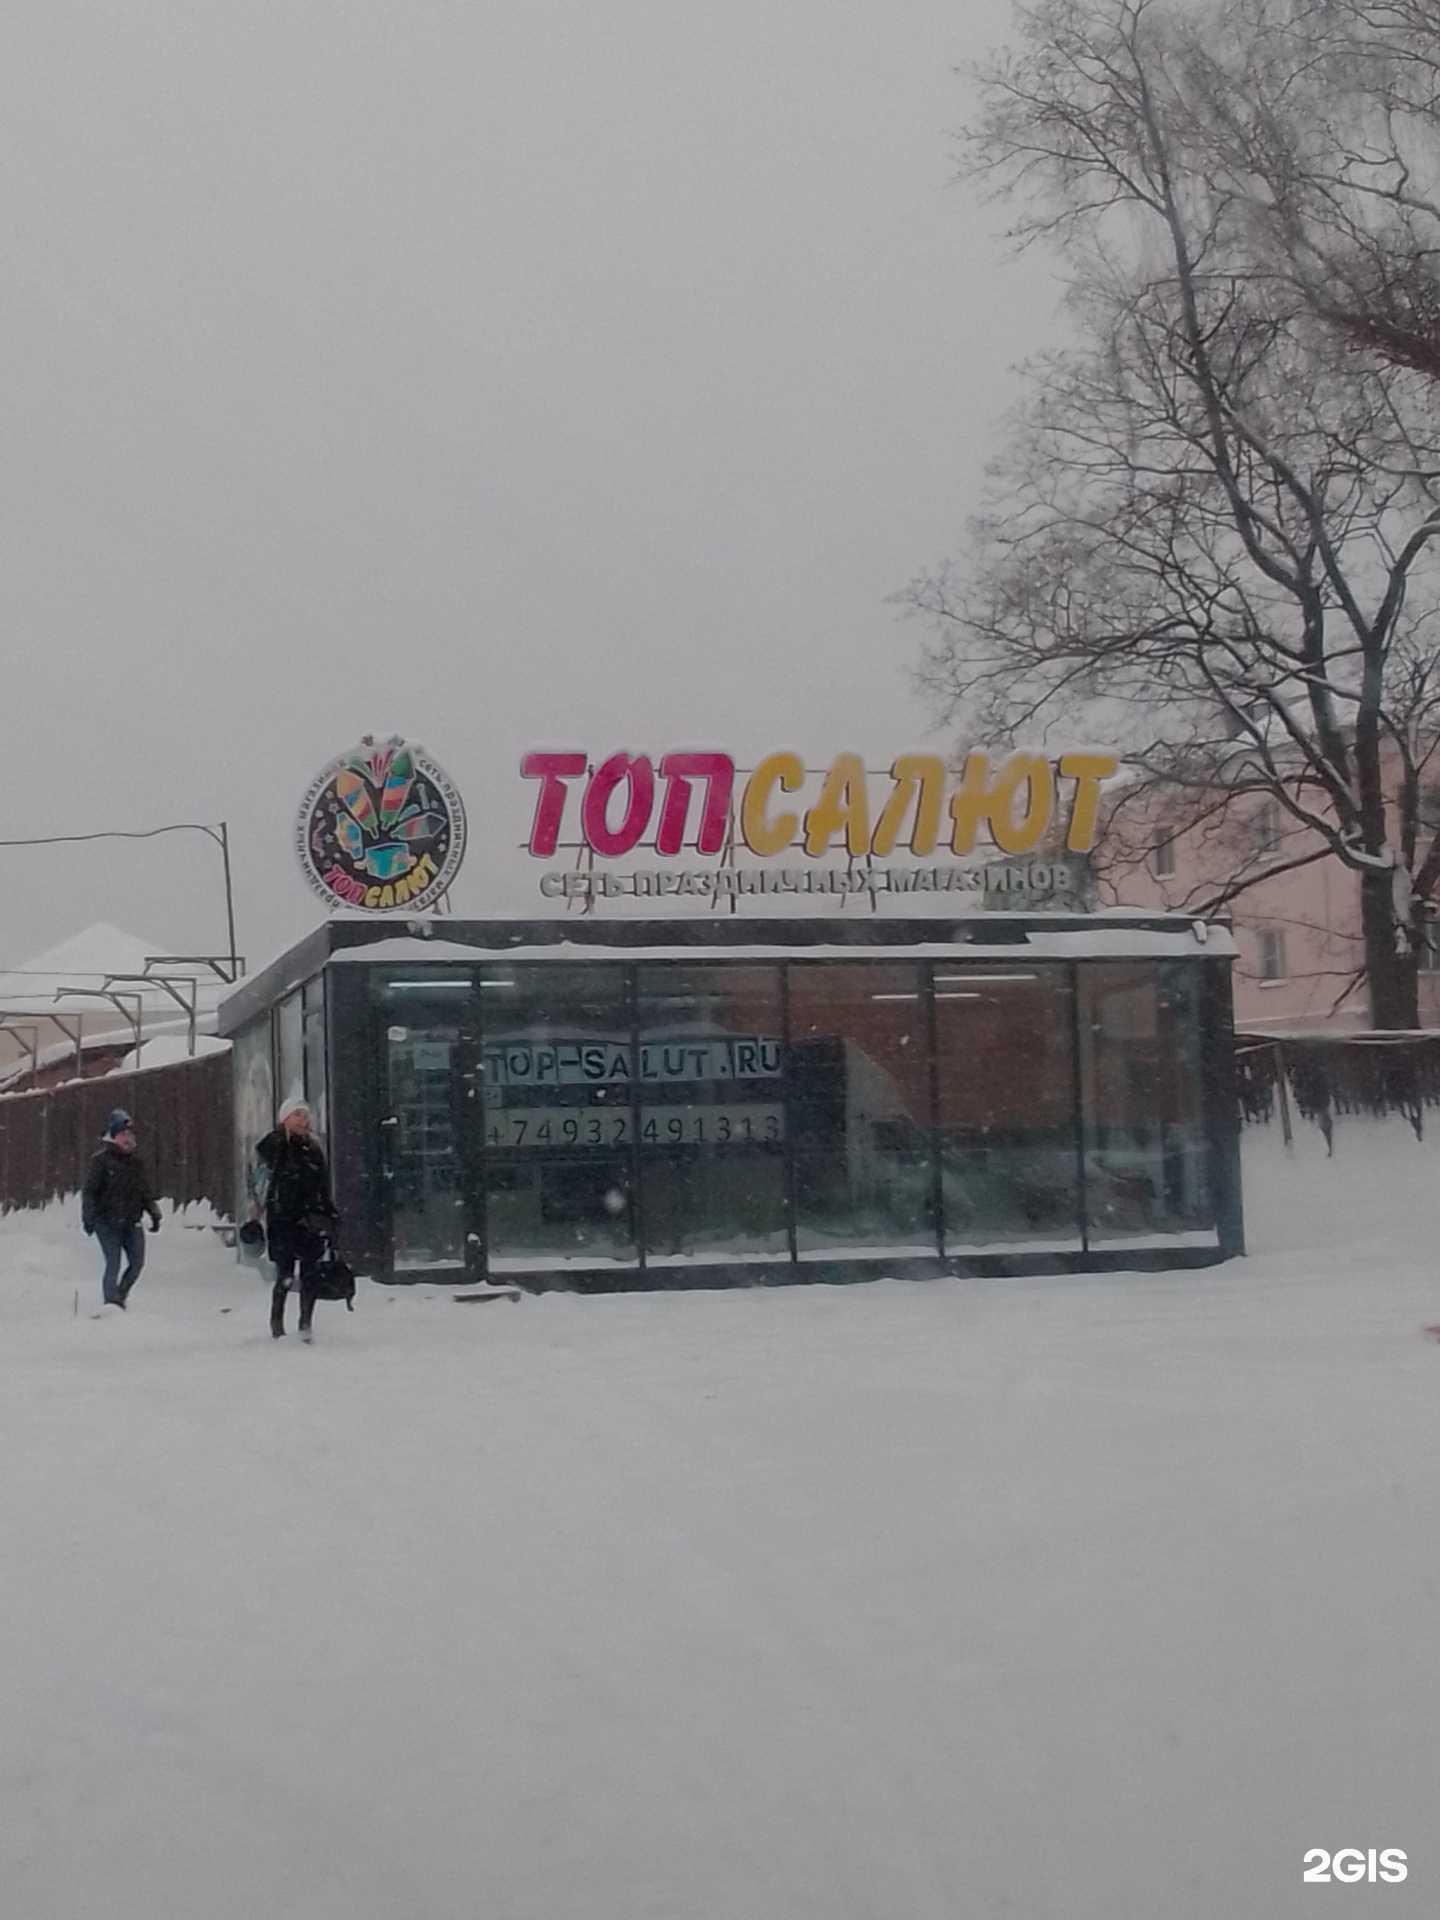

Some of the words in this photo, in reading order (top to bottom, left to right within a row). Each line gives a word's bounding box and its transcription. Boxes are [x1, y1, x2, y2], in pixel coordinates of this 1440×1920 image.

[540, 870, 624, 897] СЕТЬ
[633, 867, 877, 897] ПРАЗДНИЧНЫХ
[887, 864, 1073, 894] МАГАЗИНОВ
